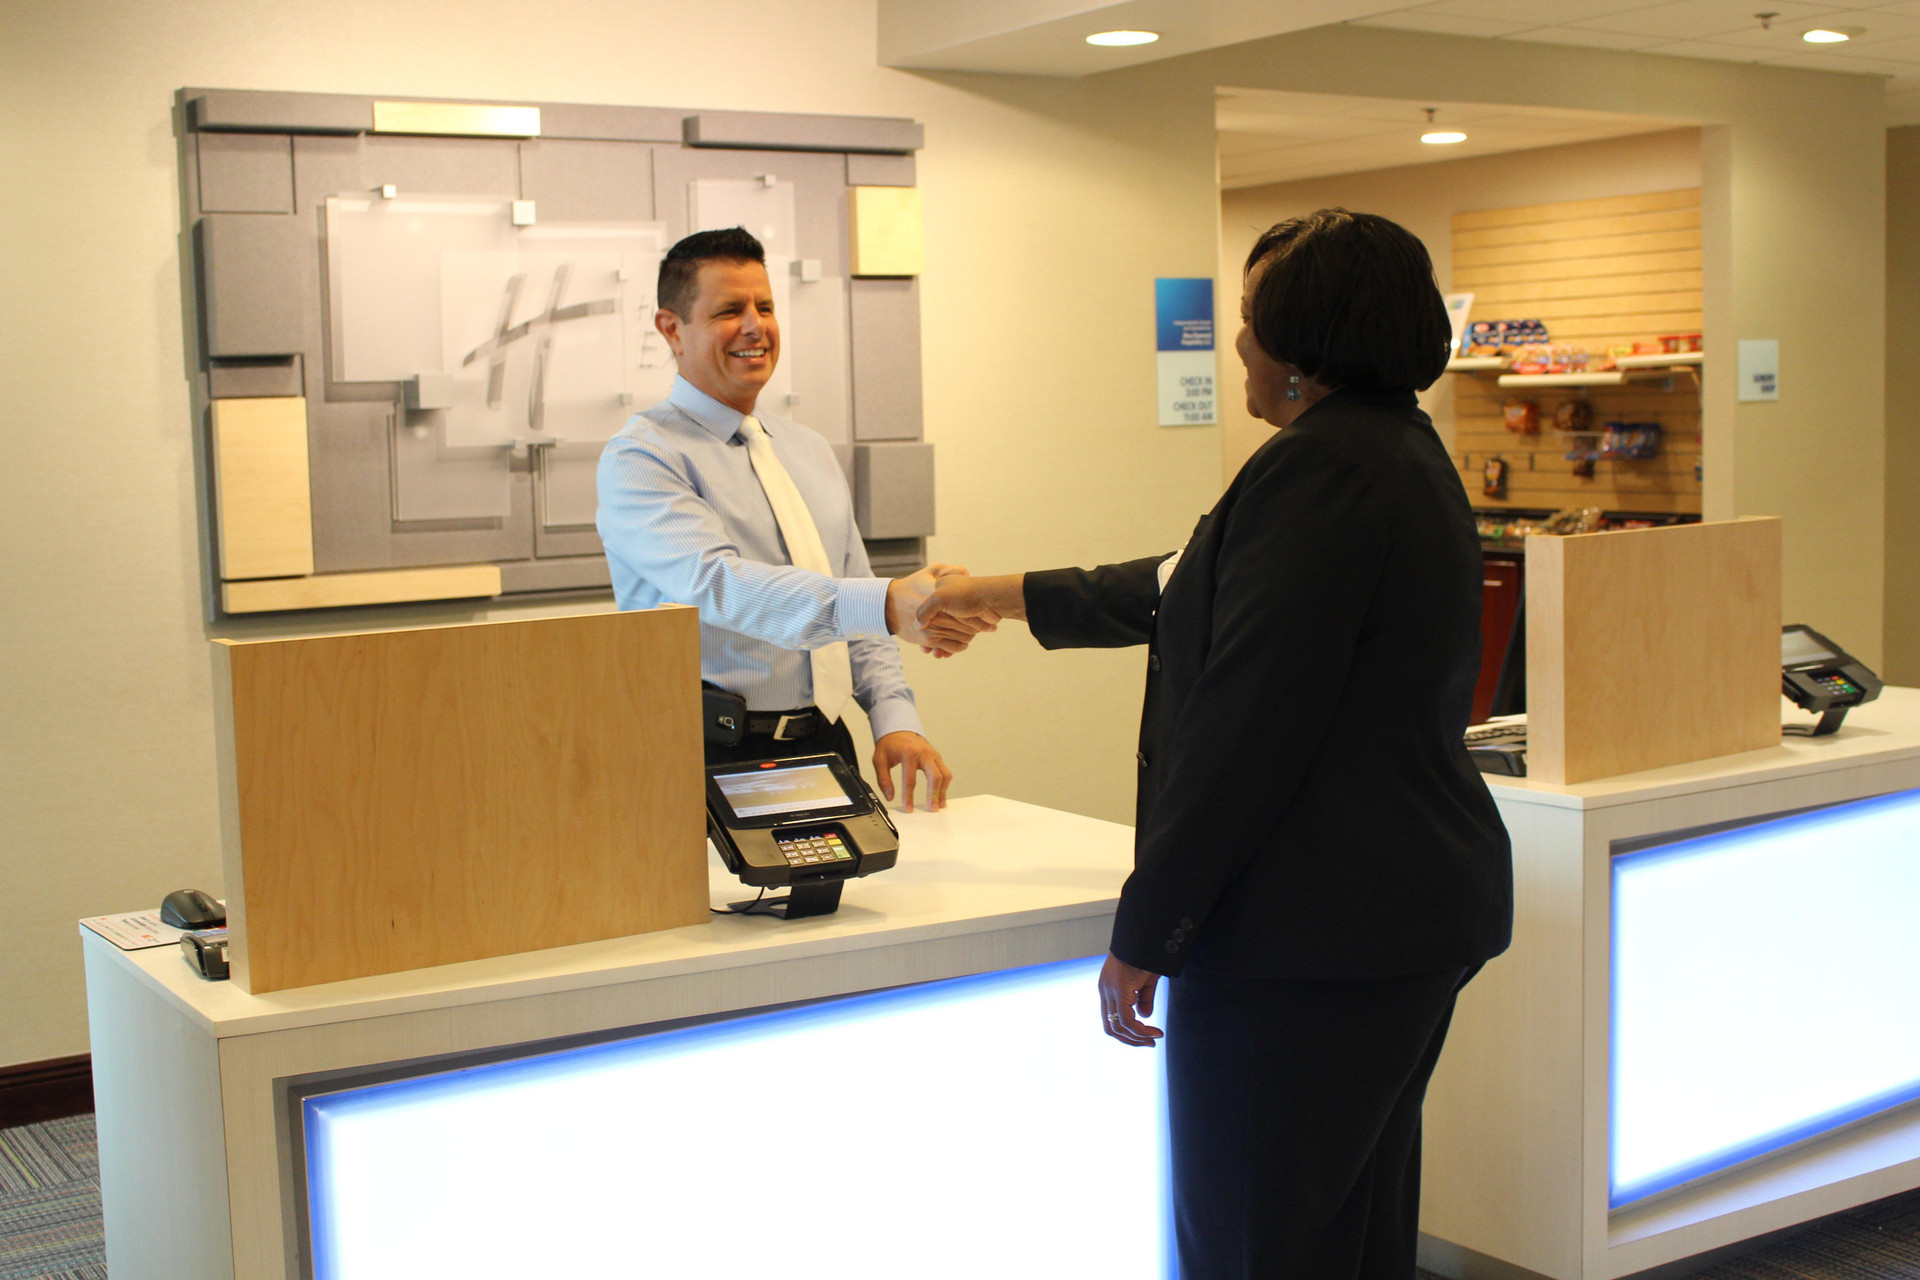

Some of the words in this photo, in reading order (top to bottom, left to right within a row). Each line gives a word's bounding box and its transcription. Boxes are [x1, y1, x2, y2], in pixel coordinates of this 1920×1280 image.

[1180, 376, 1202, 386] CHECK
[1205, 376, 1212, 385] IN
[1202, 387, 1212, 396] PM
[1173, 401, 1196, 411] CHECK
[1198, 401, 1212, 411] OUT
[1202, 412, 1213, 421] AM
